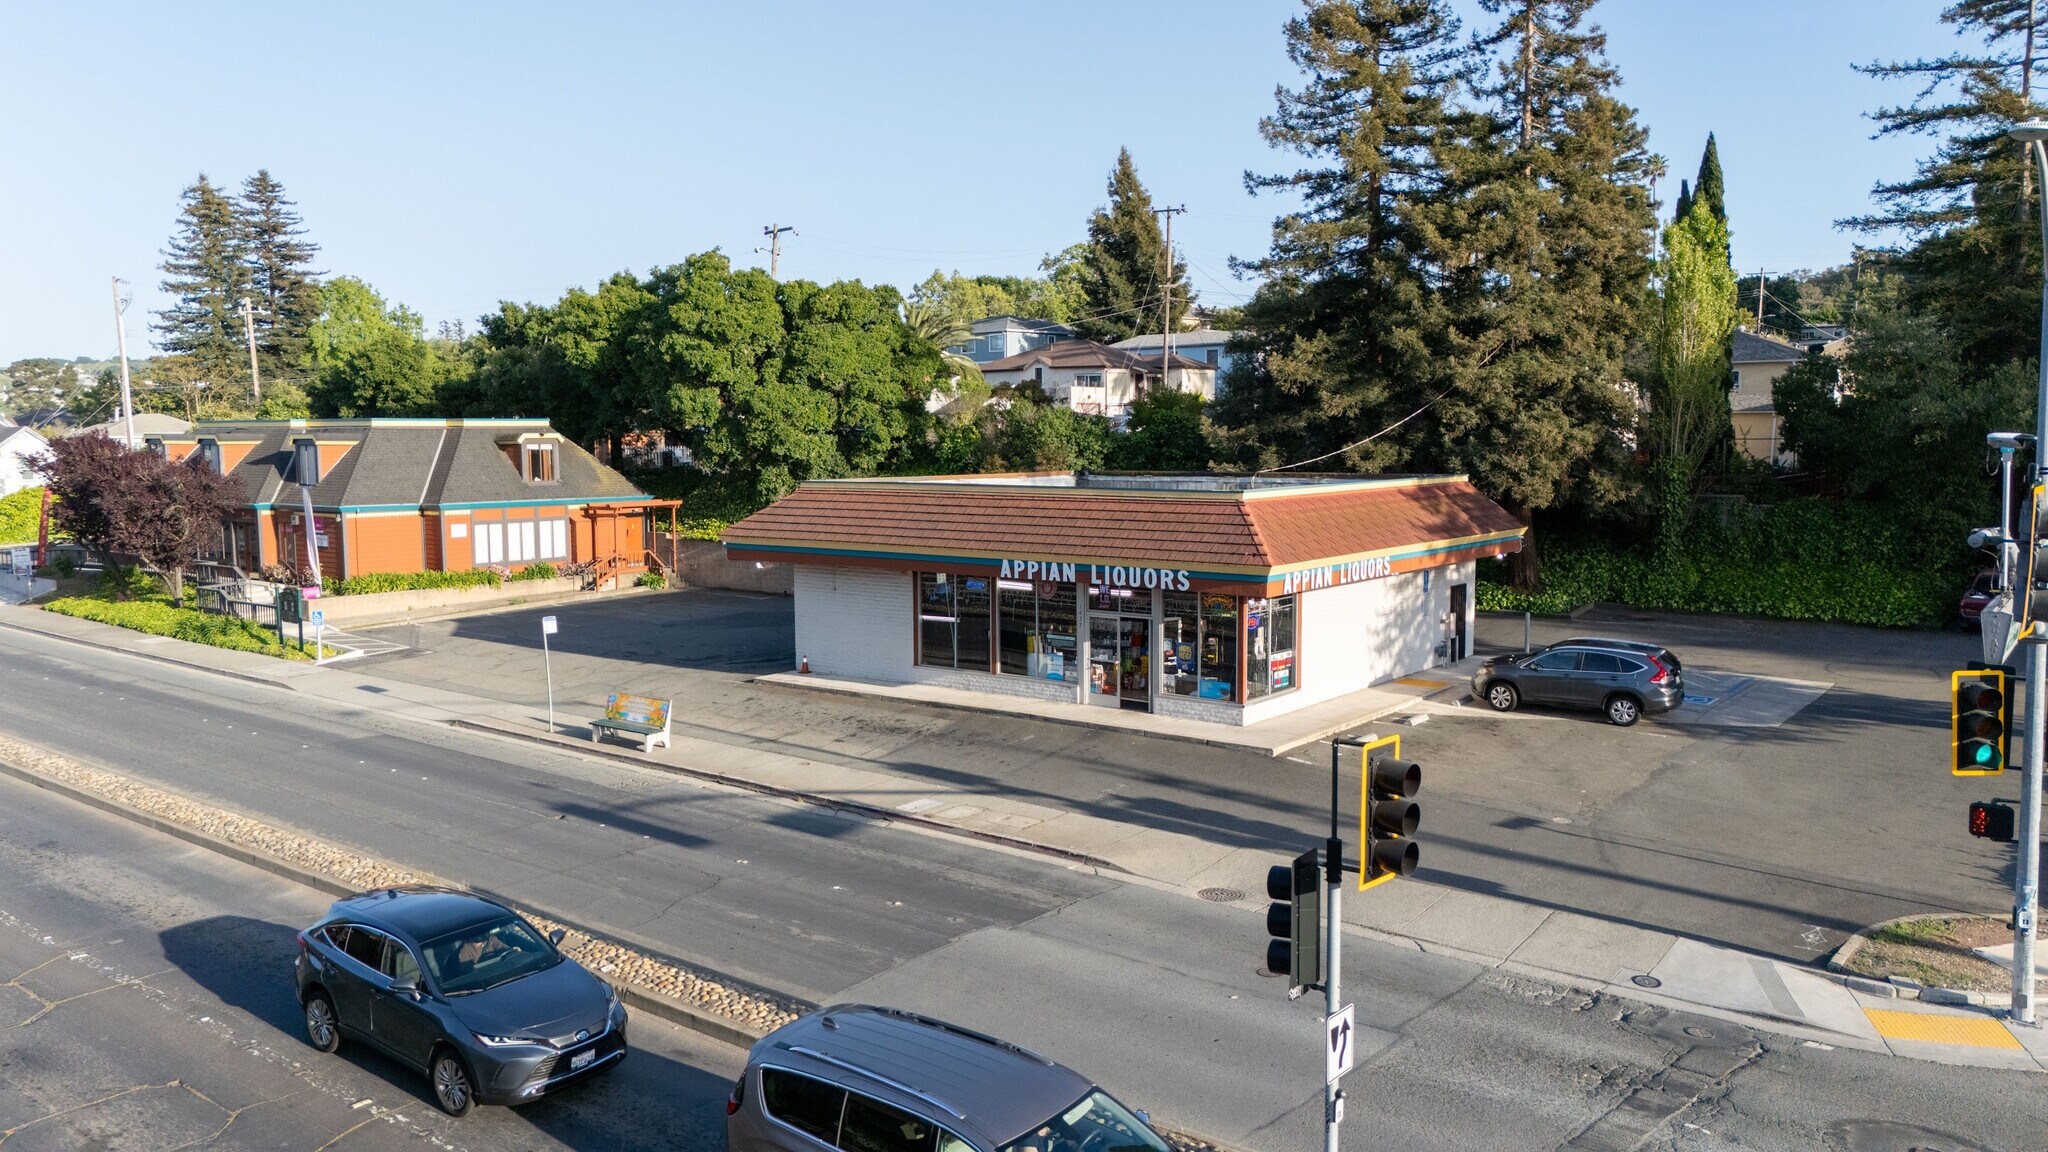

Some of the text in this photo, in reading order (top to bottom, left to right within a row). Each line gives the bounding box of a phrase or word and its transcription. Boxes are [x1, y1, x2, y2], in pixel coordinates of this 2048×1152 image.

[1000, 559, 1190, 591] APPIAN LIQUORS
[1283, 556, 1390, 594] APPIAN LIQUORS
